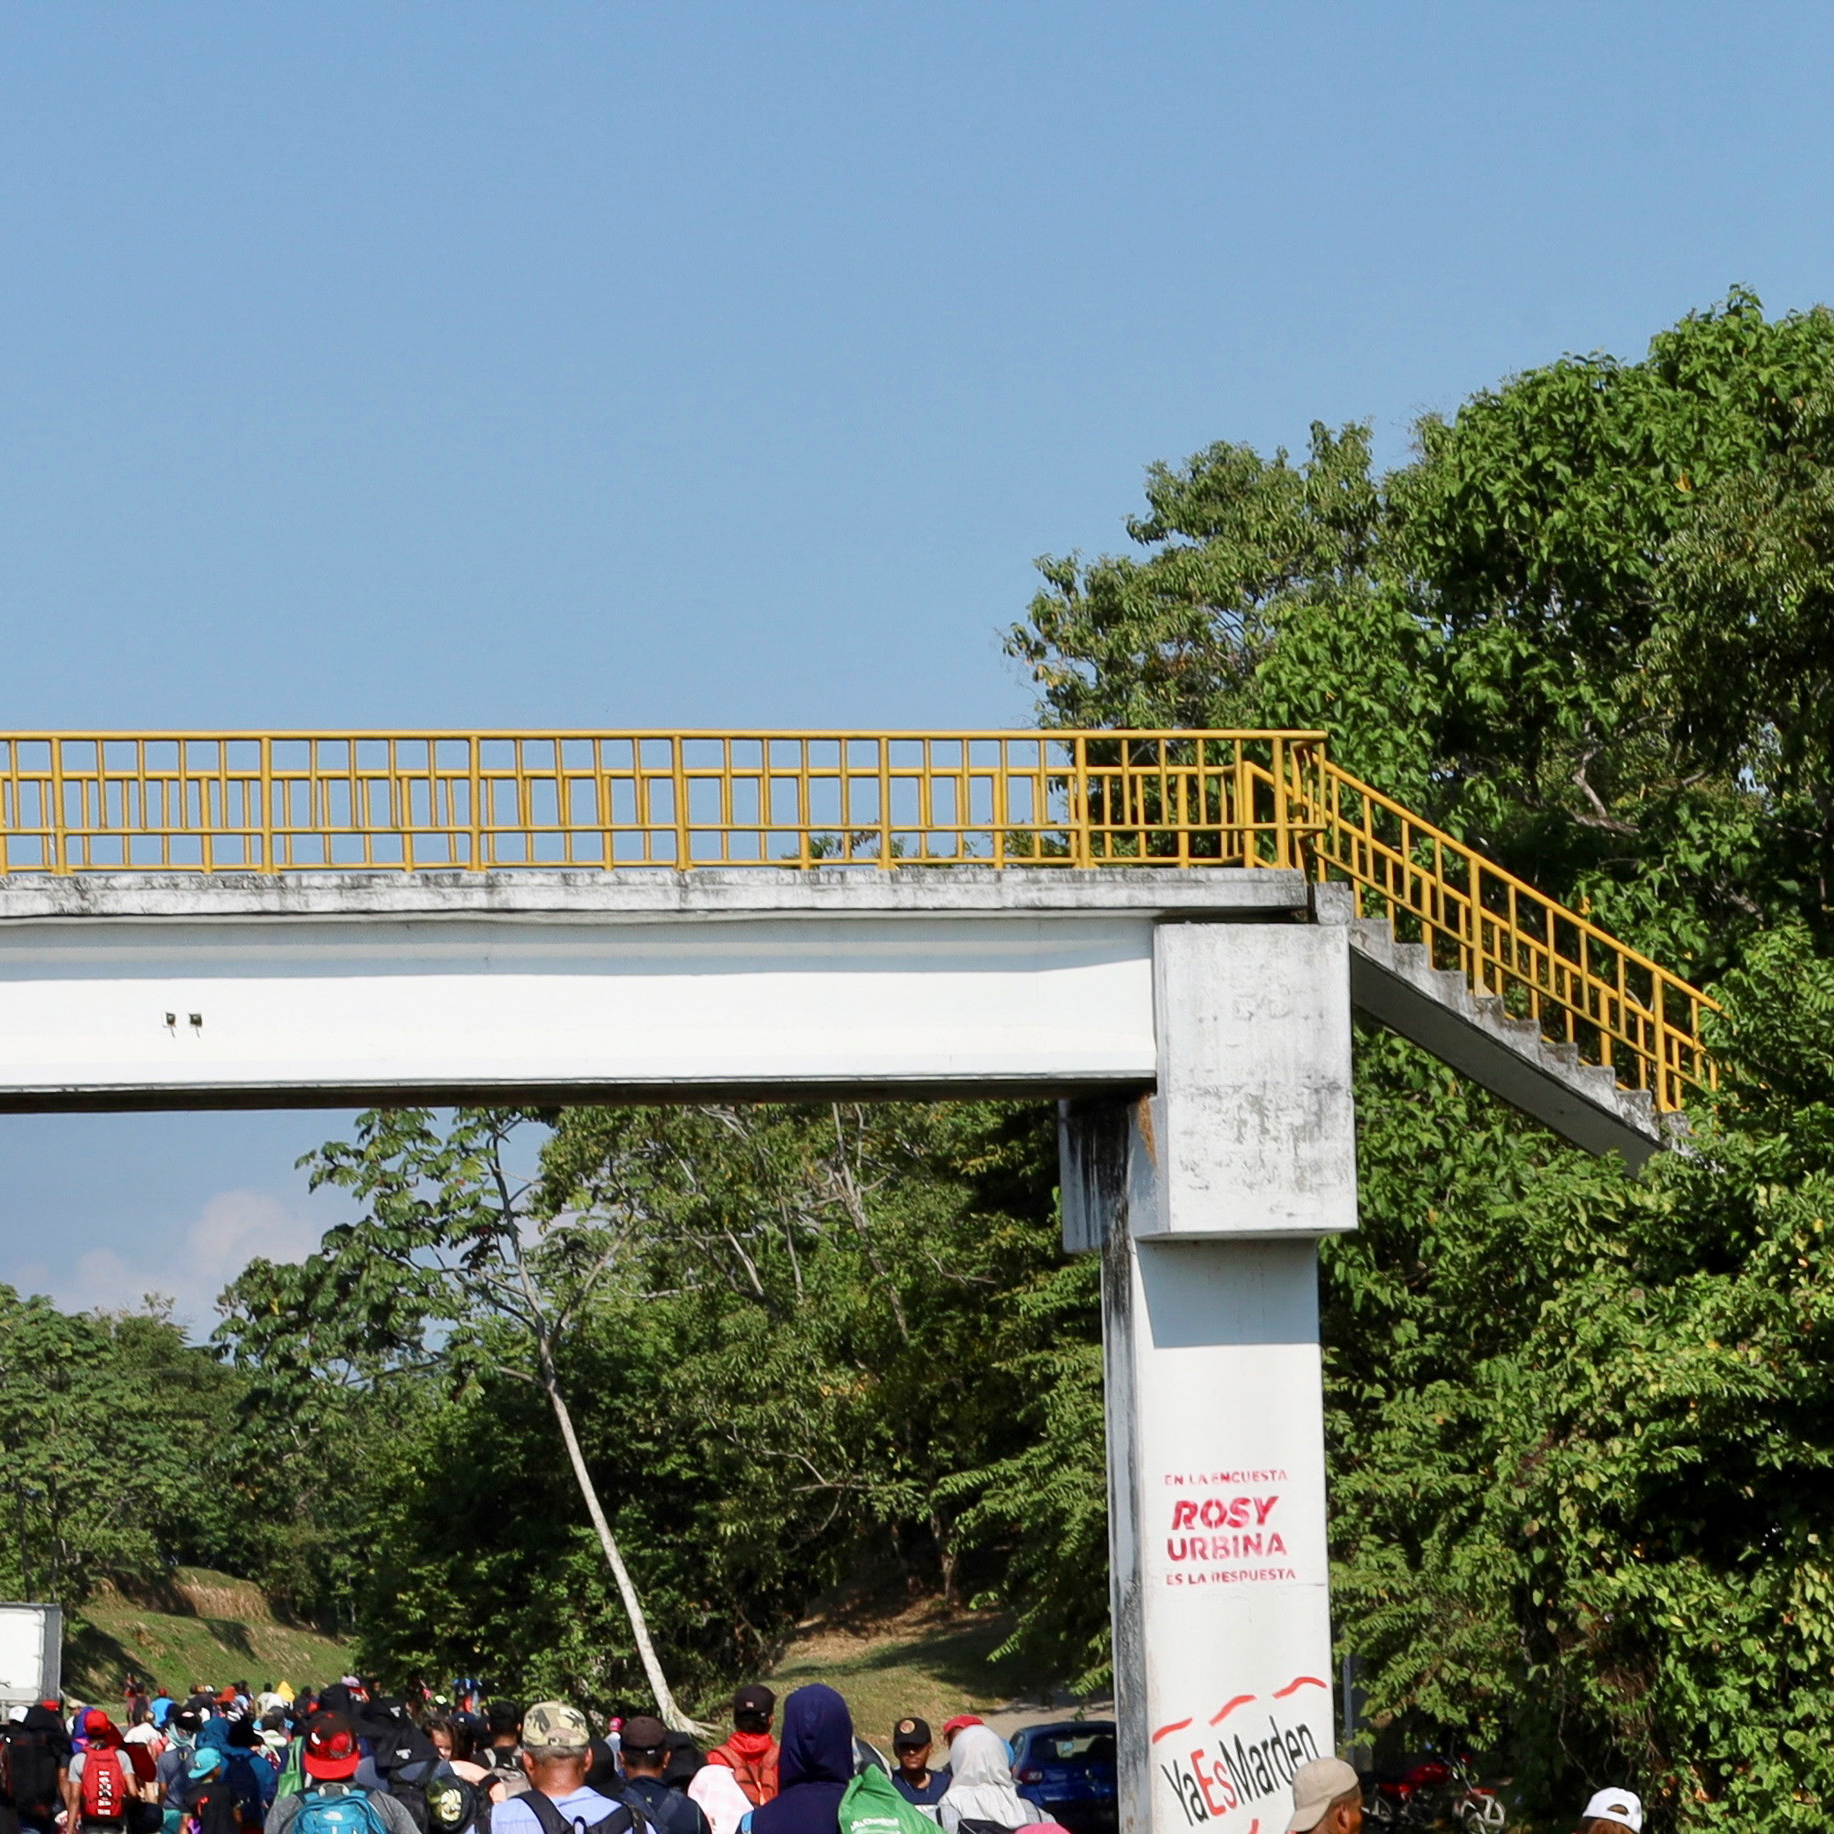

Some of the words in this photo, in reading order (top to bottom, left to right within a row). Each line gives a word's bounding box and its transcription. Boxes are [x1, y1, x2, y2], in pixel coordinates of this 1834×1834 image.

[1165, 1474, 1184, 1486] EN
[1189, 1474, 1208, 1485] LA
[1211, 1469, 1288, 1484] ENCUESTA
[1171, 1496, 1279, 1530] ROSY
[1167, 1533, 1287, 1561] URBINA
[1166, 1573, 1183, 1585] ES
[1188, 1573, 1206, 1585] LA
[1211, 1568, 1296, 1583] RESPUESTA
